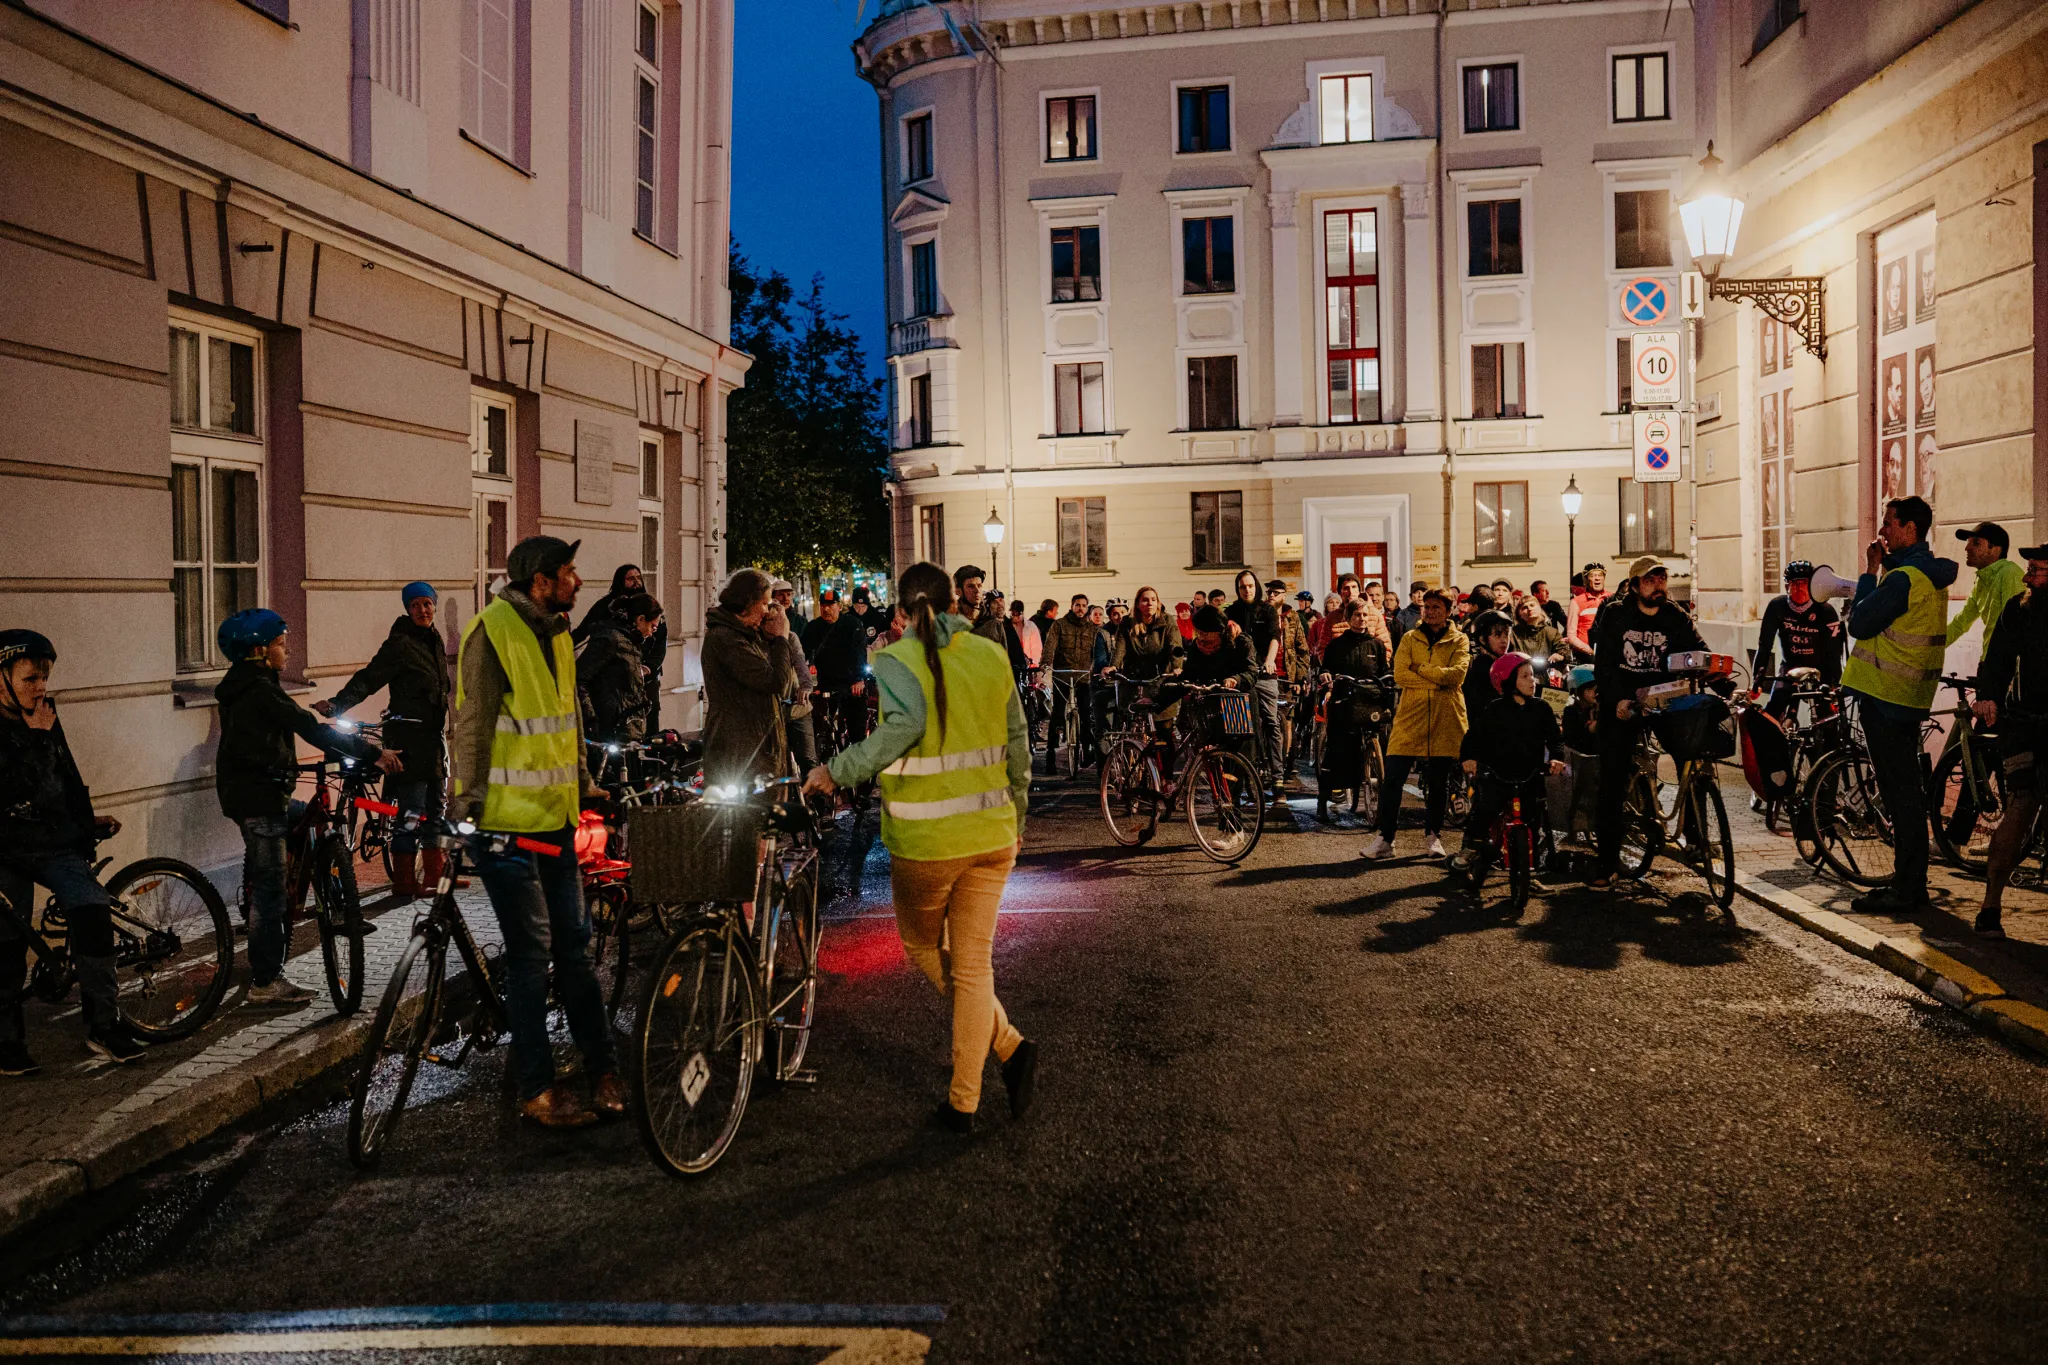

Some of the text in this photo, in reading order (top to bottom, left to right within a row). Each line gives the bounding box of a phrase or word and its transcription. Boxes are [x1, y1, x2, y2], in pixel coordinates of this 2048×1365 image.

[1647, 335, 1666, 343] ALA
[1647, 357, 1668, 374] 10
[1647, 412, 1667, 421] ALA
